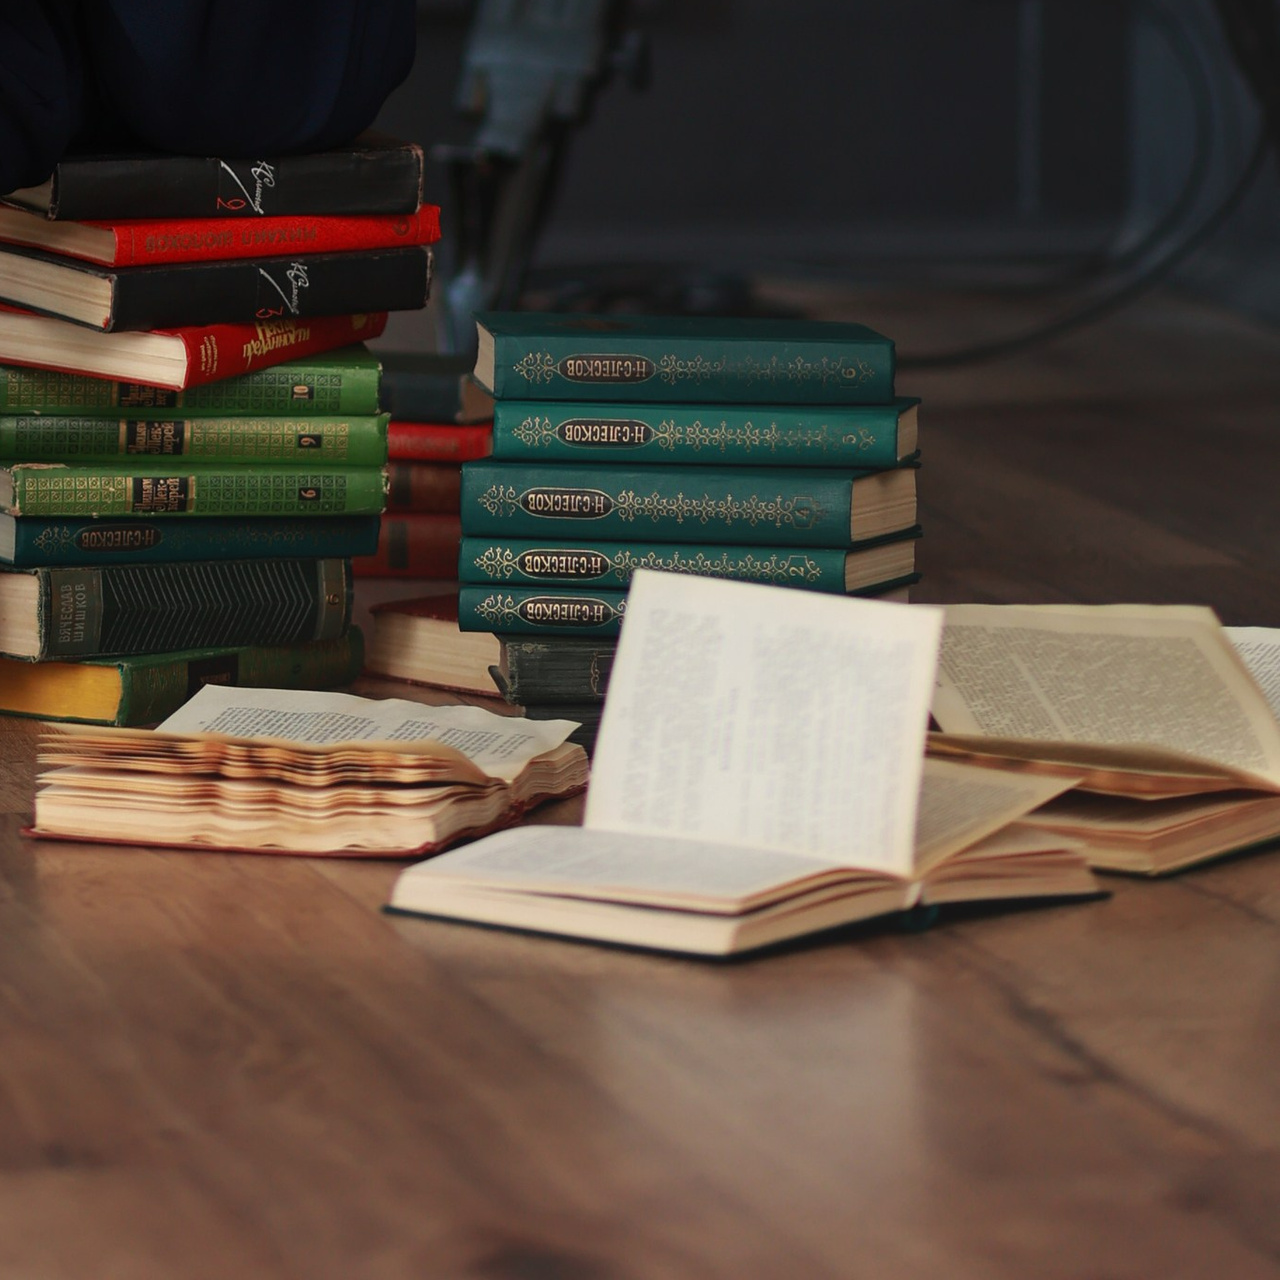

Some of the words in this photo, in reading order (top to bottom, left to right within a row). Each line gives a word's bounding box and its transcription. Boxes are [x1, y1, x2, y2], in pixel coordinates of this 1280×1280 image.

[145, 230, 234, 253] ШОЛОХОВ
[242, 225, 318, 246] МИХАИЛ
[292, 385, 309, 399] 10
[58, 583, 73, 643] ВЯЧЕСЛАВ
[73, 583, 87, 643] ШИШКОВ
